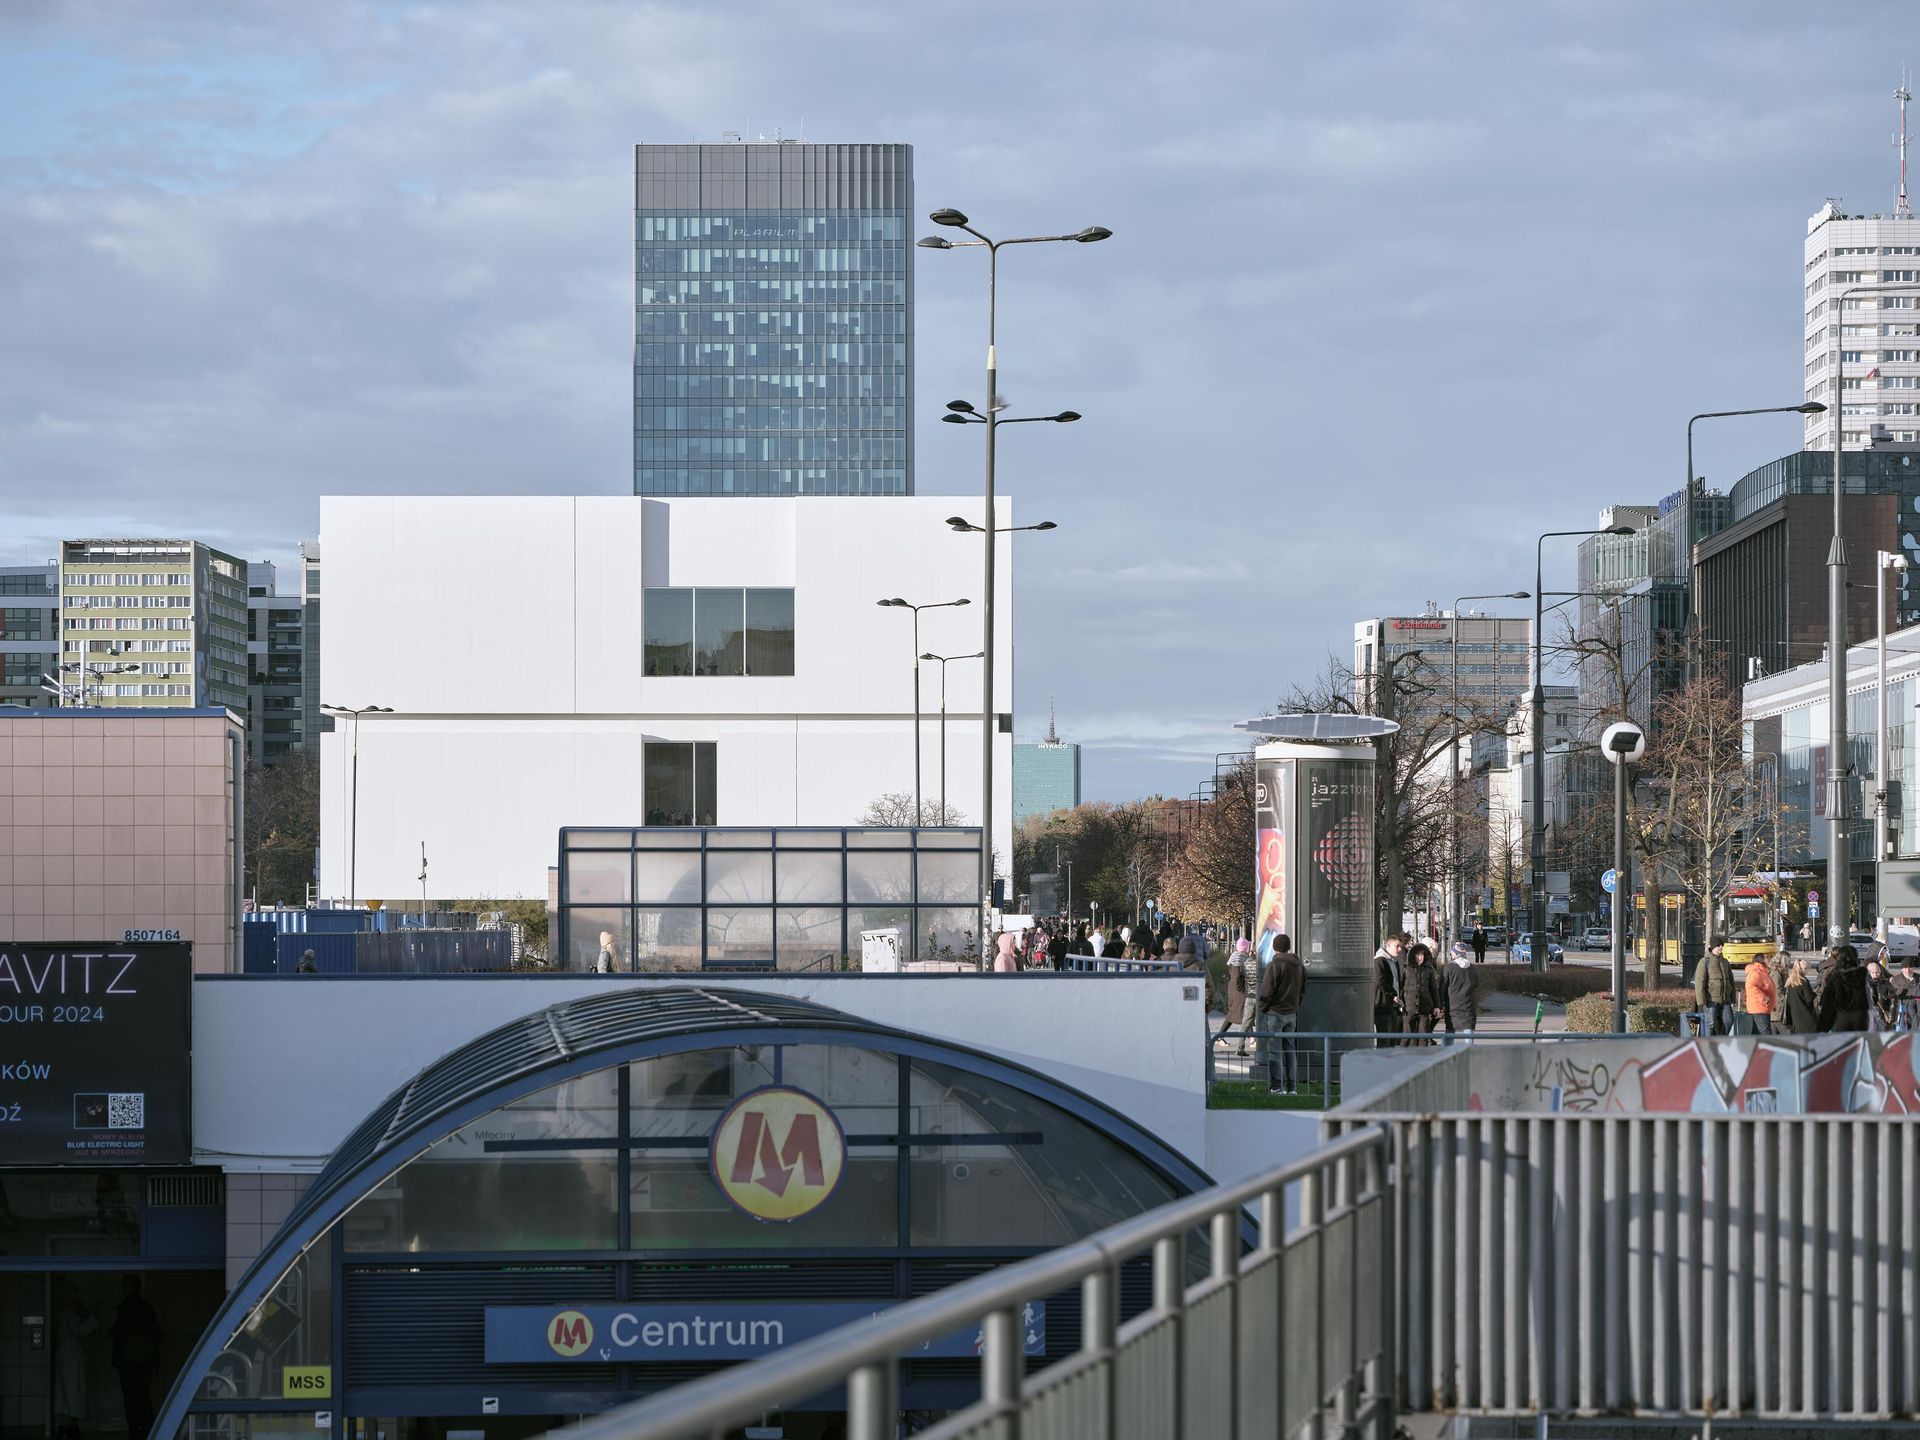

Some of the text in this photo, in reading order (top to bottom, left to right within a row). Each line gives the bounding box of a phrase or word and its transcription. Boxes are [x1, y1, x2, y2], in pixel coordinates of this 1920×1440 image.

[124, 930, 181, 941] 8507164
[0, 1006, 105, 1023] OUR 2024
[2, 1060, 51, 1080] KÓW
[66, 1141, 85, 1149] BLUE
[87, 1141, 121, 1149] ELECTRIC
[610, 1312, 784, 1347] Centrum
[289, 1375, 326, 1390] MSS
